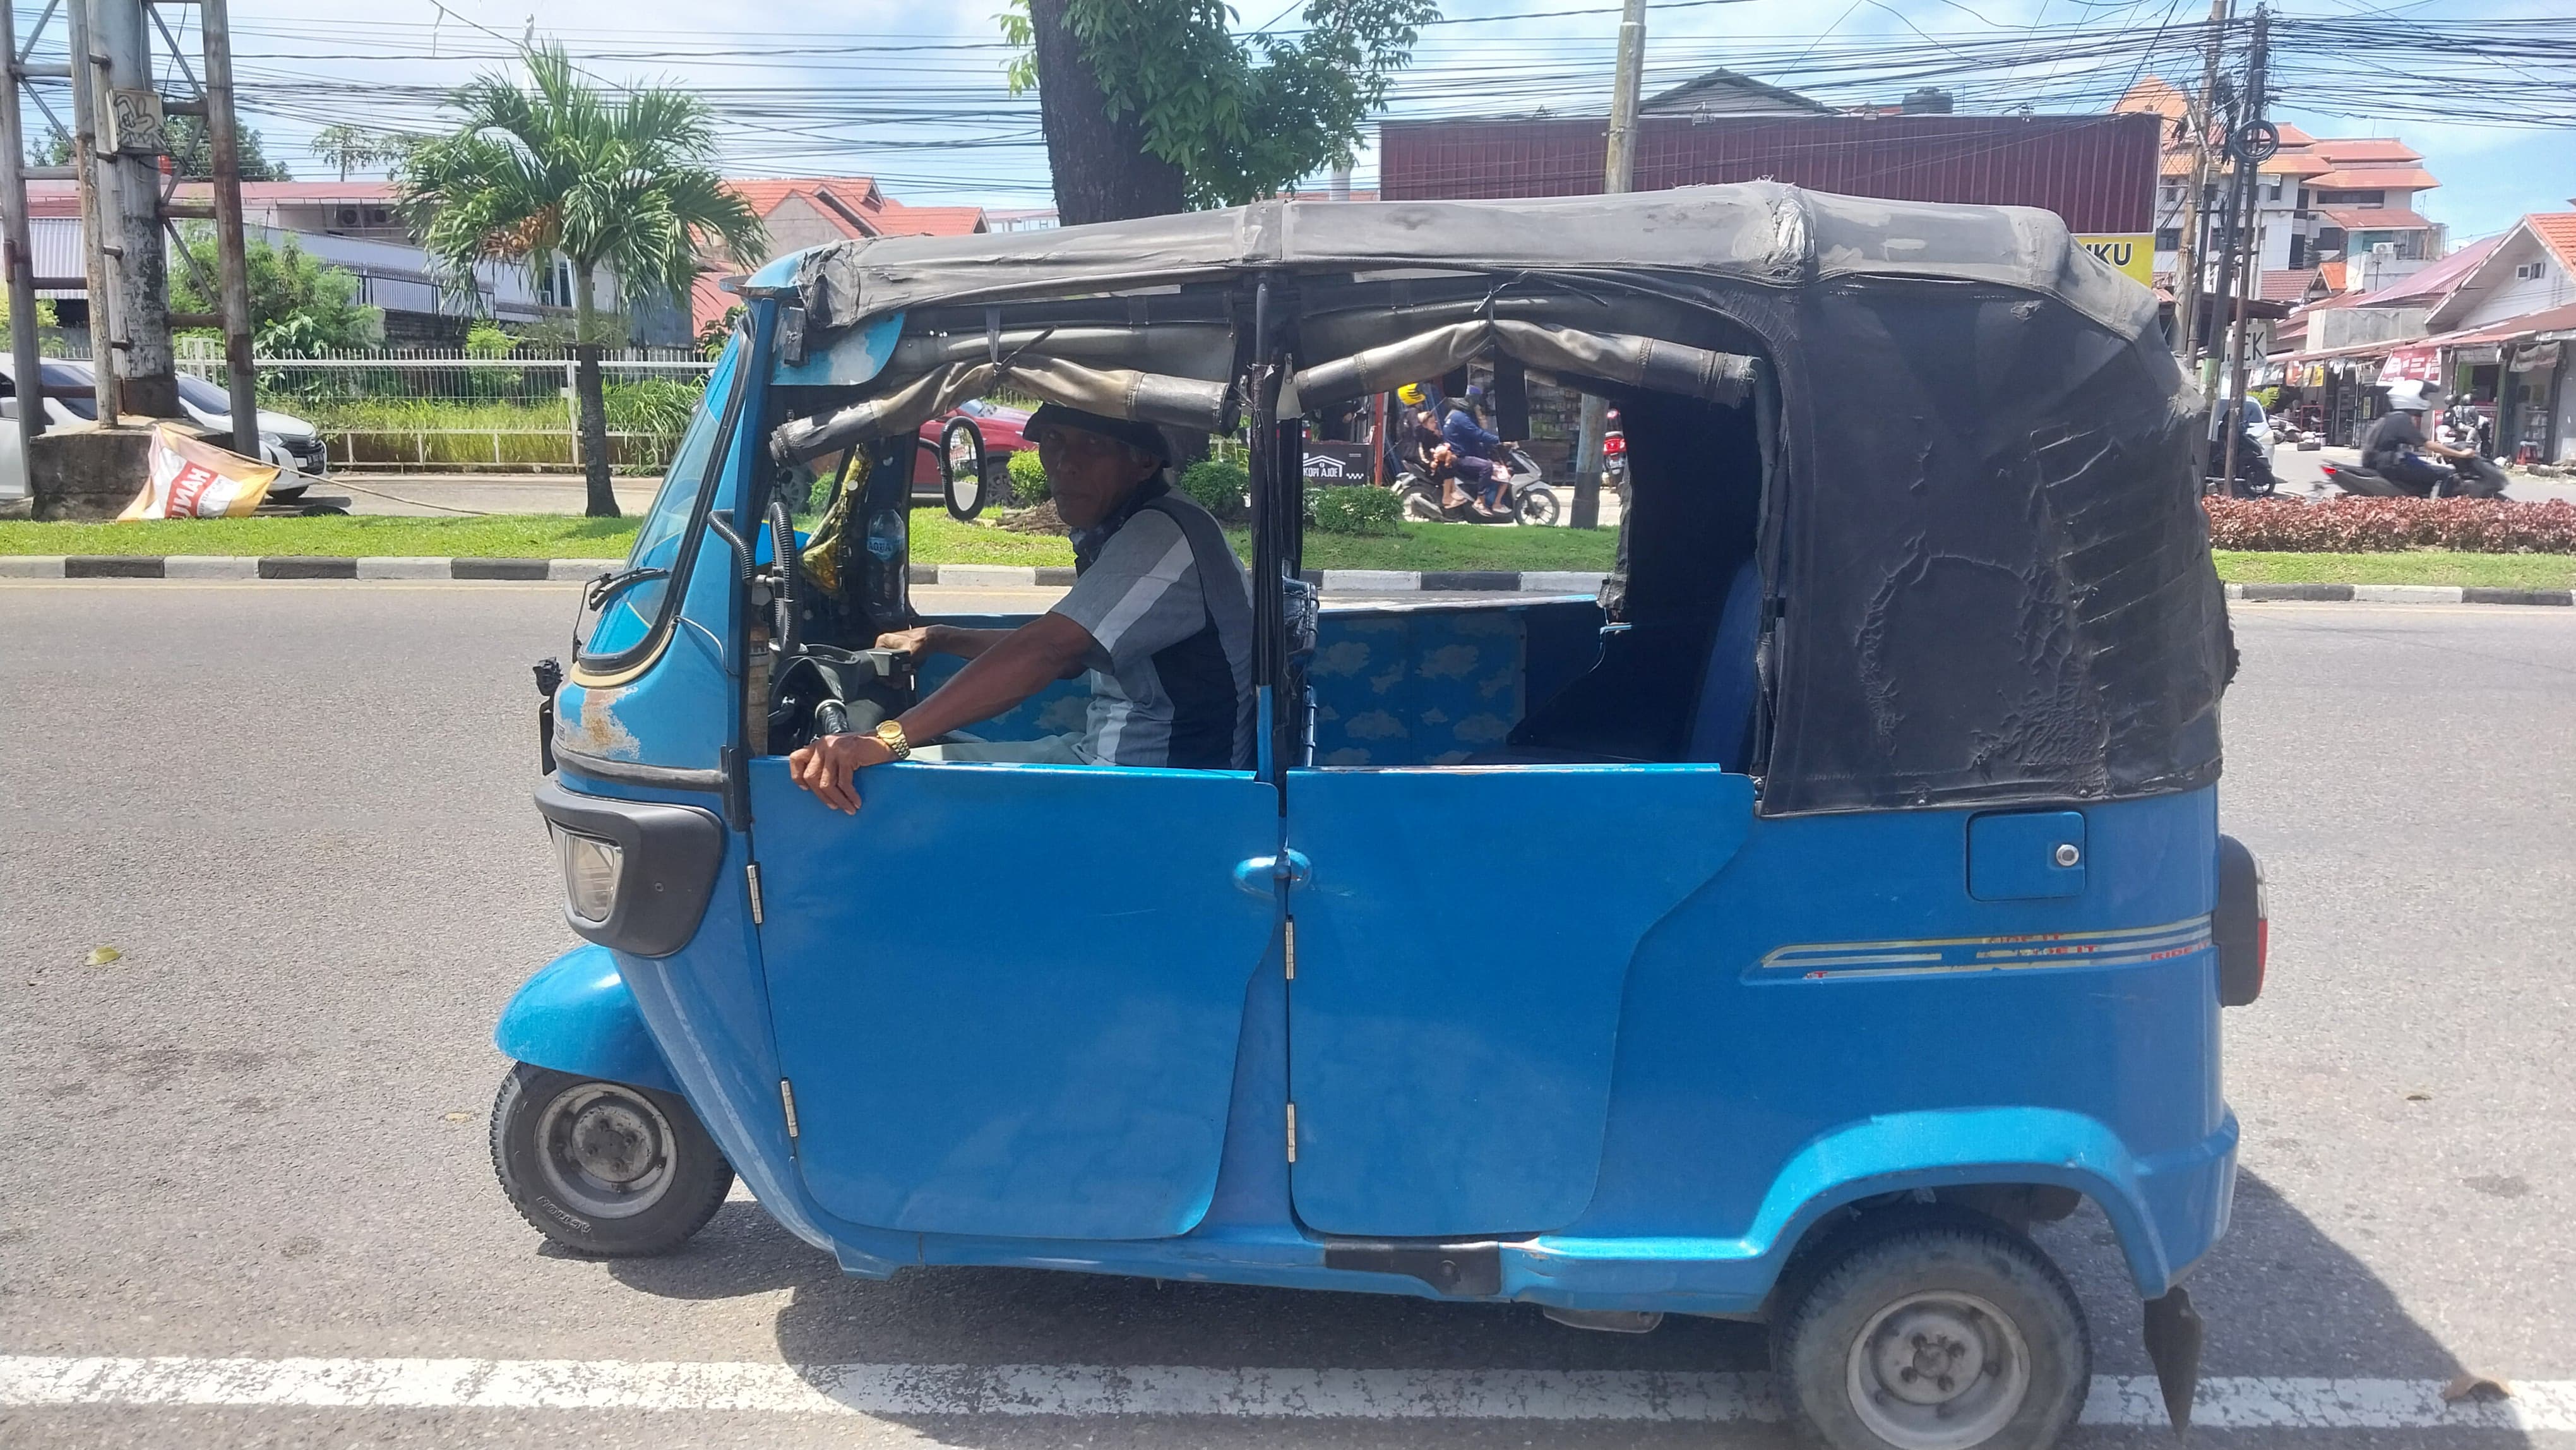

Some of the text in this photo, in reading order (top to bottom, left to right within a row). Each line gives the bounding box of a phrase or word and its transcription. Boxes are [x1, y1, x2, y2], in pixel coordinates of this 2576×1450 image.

[1303, 467, 1320, 477] KOPI
[868, 541, 891, 553] AQUA
[2072, 944, 2094, 953] IT
[2151, 946, 2192, 960] RIDE
